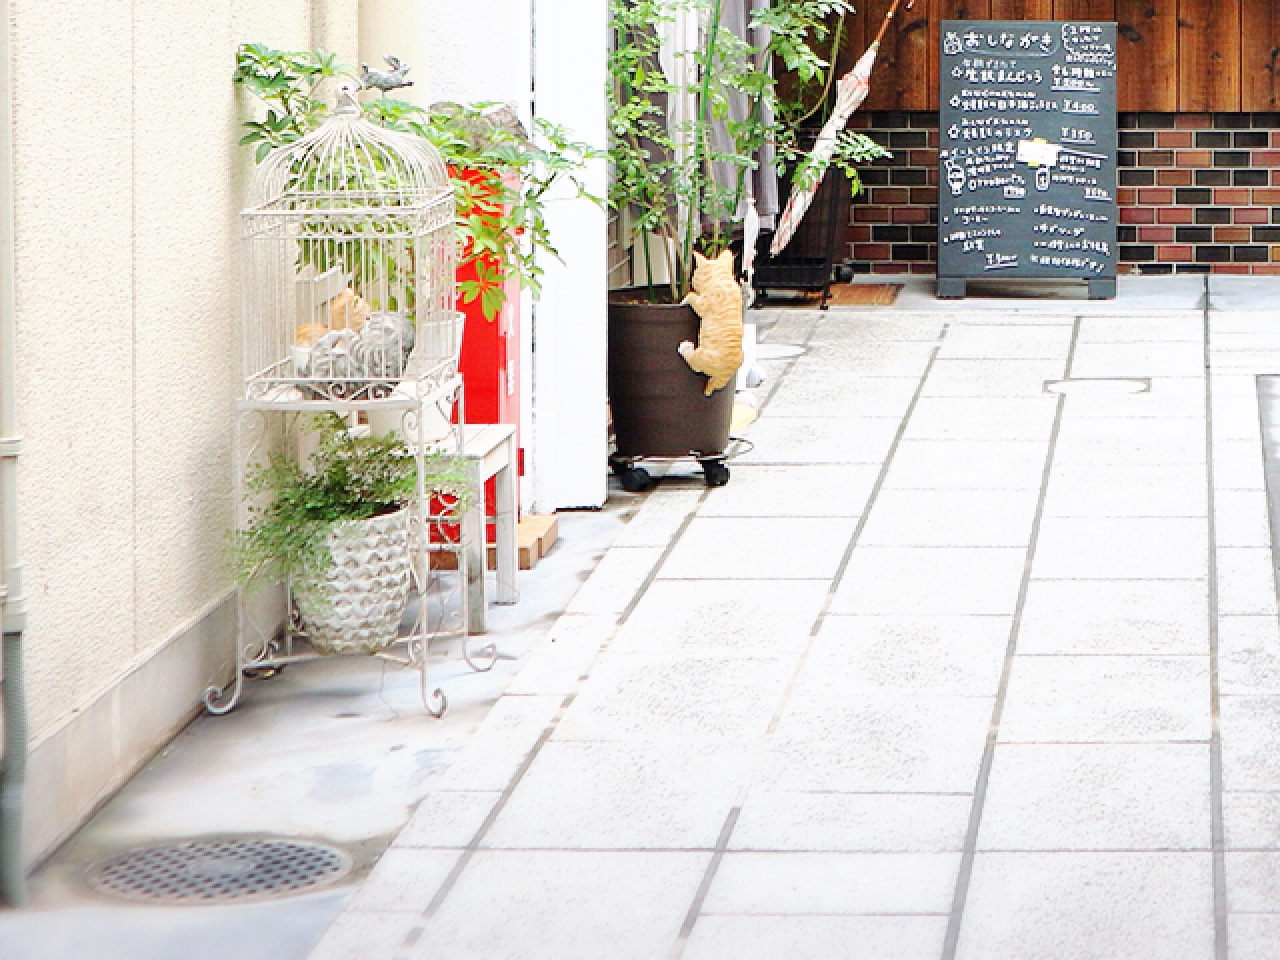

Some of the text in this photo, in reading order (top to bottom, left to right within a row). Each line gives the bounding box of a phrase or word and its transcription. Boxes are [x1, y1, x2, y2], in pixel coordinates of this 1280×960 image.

[963, 31, 1053, 53] おしながき
